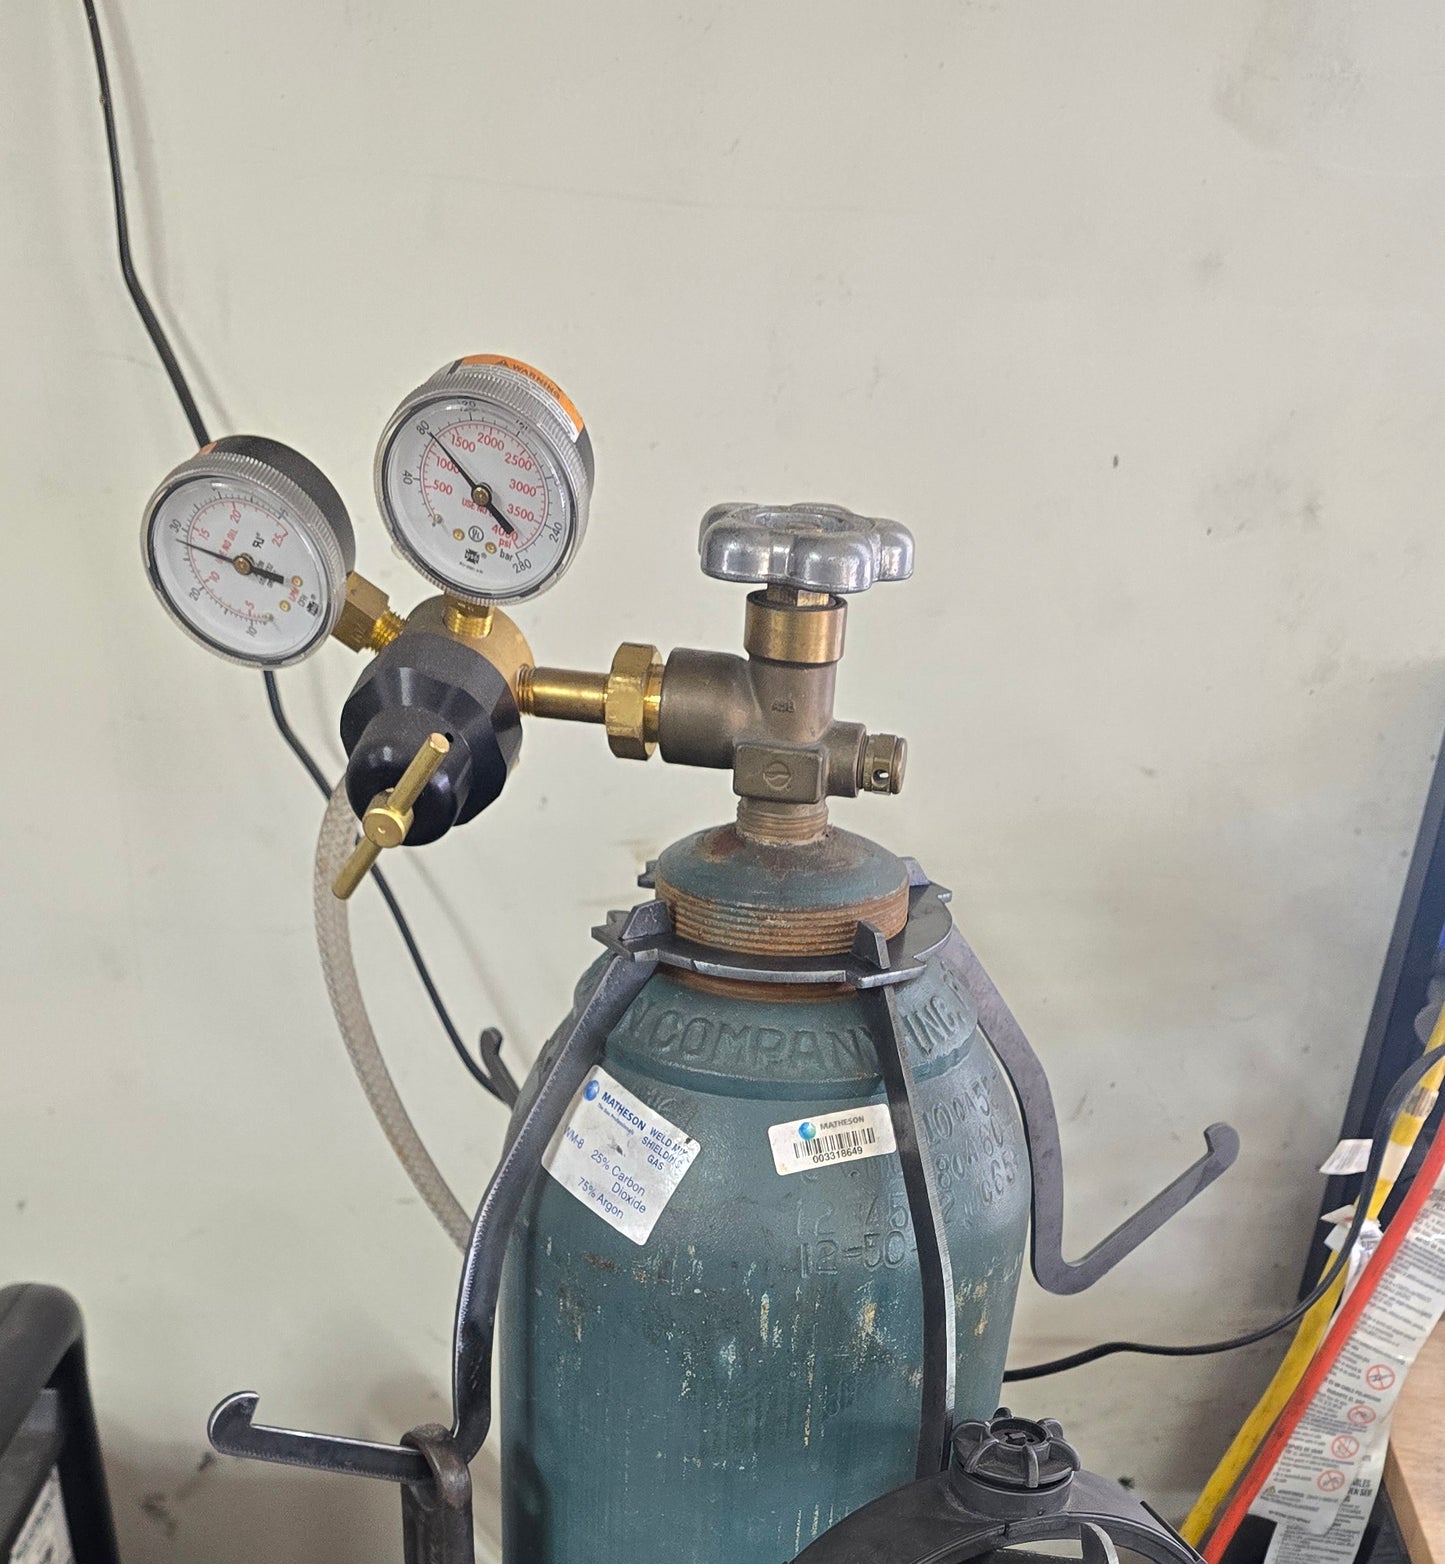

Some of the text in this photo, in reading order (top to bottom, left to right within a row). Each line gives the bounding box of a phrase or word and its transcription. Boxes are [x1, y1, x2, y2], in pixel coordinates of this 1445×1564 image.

[416, 420, 430, 436] 80
[450, 434, 476, 453] 1500
[477, 432, 505, 451] 2000
[435, 455, 460, 474] 1000
[504, 452, 532, 471] 2500
[402, 470, 413, 485] 40
[433, 479, 453, 495] 500
[508, 478, 537, 497] 3000
[230, 509, 242, 524] 20
[506, 503, 535, 522] 3500
[169, 518, 182, 534] 30
[198, 528, 210, 540] 15
[548, 521, 563, 544] 240
[271, 534, 285, 548] 25
[498, 538, 513, 549] psi
[499, 548, 514, 562] bar
[512, 558, 532, 574] 280
[209, 571, 221, 584] 10
[188, 586, 201, 602] 20
[244, 600, 255, 609] 5
[245, 627, 258, 638] 10
[601, 1091, 647, 1132] MATHESON
[820, 1115, 865, 1131] MATHESON
[649, 1126, 673, 1148] WELD
[647, 1154, 666, 1171] GAS
[812, 1146, 864, 1164] 003318649
[590, 1149, 646, 1197] 25% Carbon
[578, 1176, 625, 1220] 75% Argon
[611, 1183, 647, 1214] Dioxide
